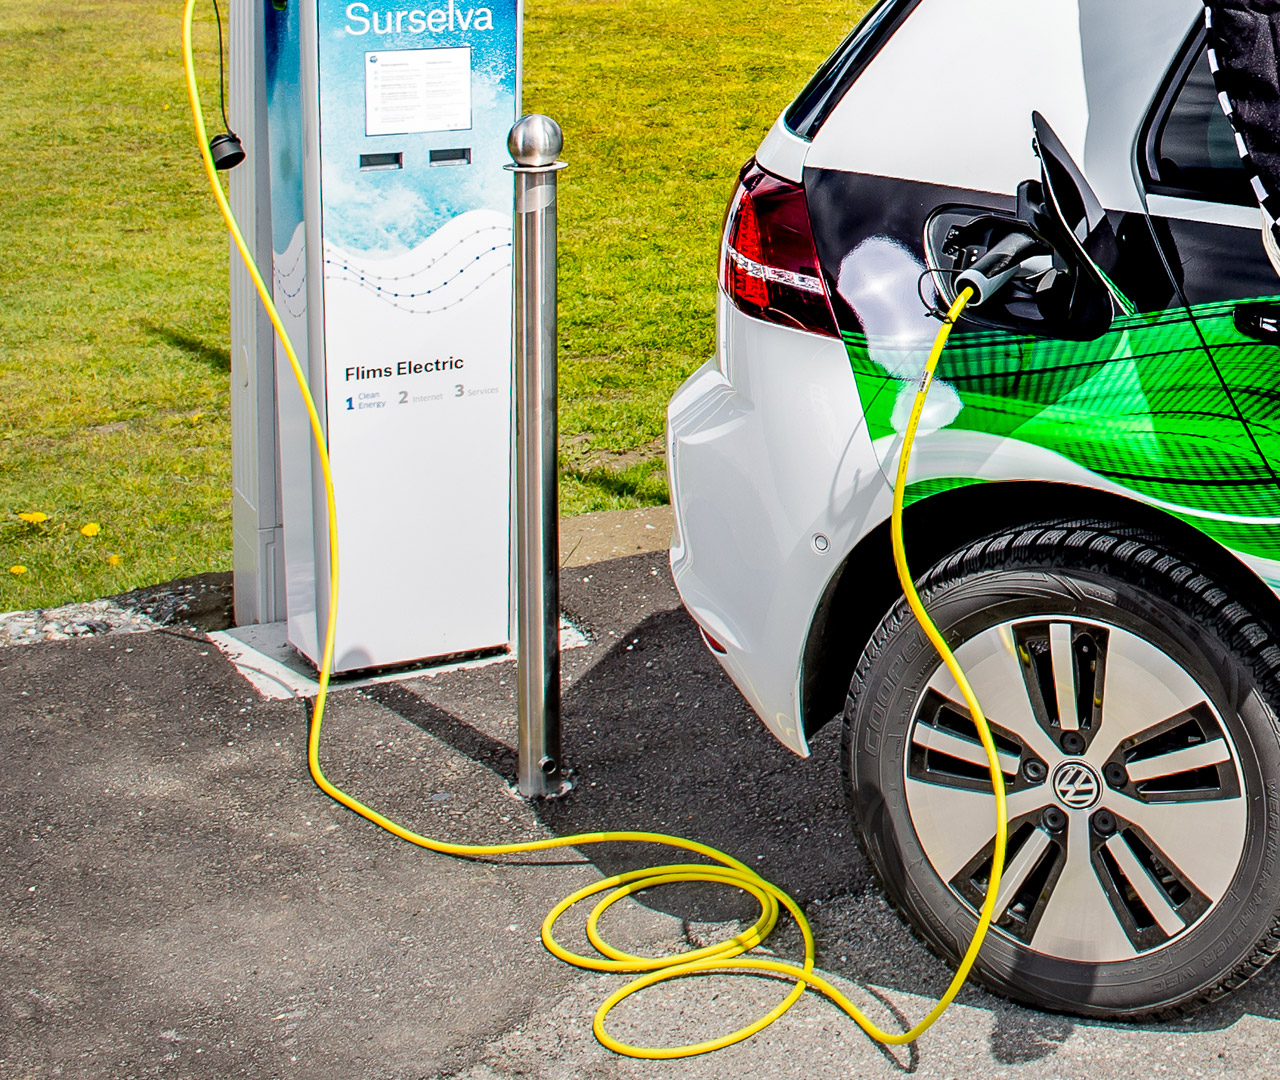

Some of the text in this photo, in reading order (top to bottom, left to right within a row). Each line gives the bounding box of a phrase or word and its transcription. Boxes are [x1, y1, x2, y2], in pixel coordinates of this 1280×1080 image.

[345, 356, 464, 381] Flims Electric
[358, 391, 380, 400] Clean
[398, 391, 444, 404] 2 Internet
[454, 384, 499, 398] 3 Services
[345, 397, 355, 410] 1
[358, 400, 387, 409] Energy
